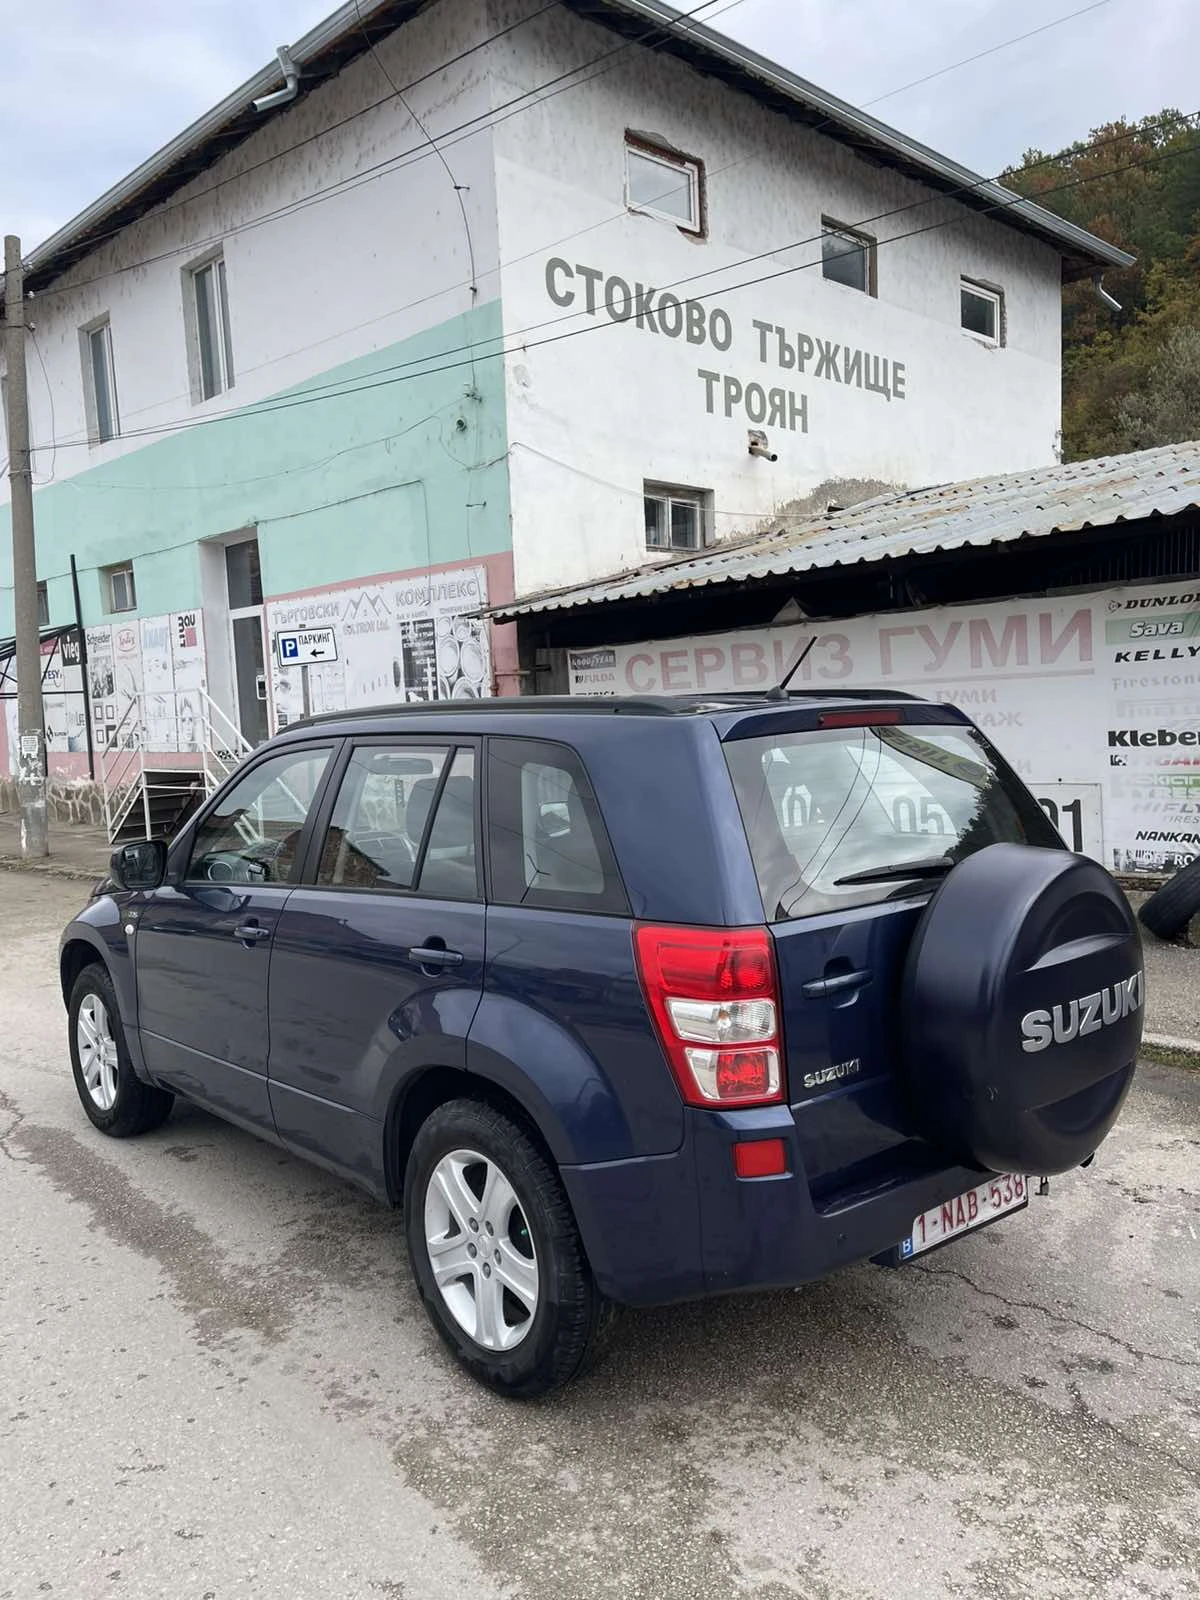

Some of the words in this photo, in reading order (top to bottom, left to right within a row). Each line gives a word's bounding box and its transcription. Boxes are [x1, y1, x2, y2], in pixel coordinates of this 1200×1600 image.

[545, 257, 732, 351] СТОКОВО
[752, 319, 906, 402] ТЪРЖИЩЕ
[697, 368, 809, 433] ТРОЯН
[272, 602, 340, 625] ТЪРГОВСКИ
[395, 580, 477, 607] КОМПЛЕКС
[298, 632, 331, 646] ПАРКИНГ
[1129, 621, 1185, 638] Sava
[571, 653, 614, 667] GOODYEAR
[624, 632, 855, 692] СЕРВИЗ
[878, 607, 1093, 676] ГУМИ
[1114, 646, 1200, 663] KELLY
[935, 687, 998, 703] ГУМИ
[1111, 674, 1200, 691] Fireston
[1037, 797, 1094, 853] 1
[1020, 971, 1145, 1053] SUZUKI
[803, 1057, 861, 1090] SUZUKI
[902, 1238, 912, 1254] B
